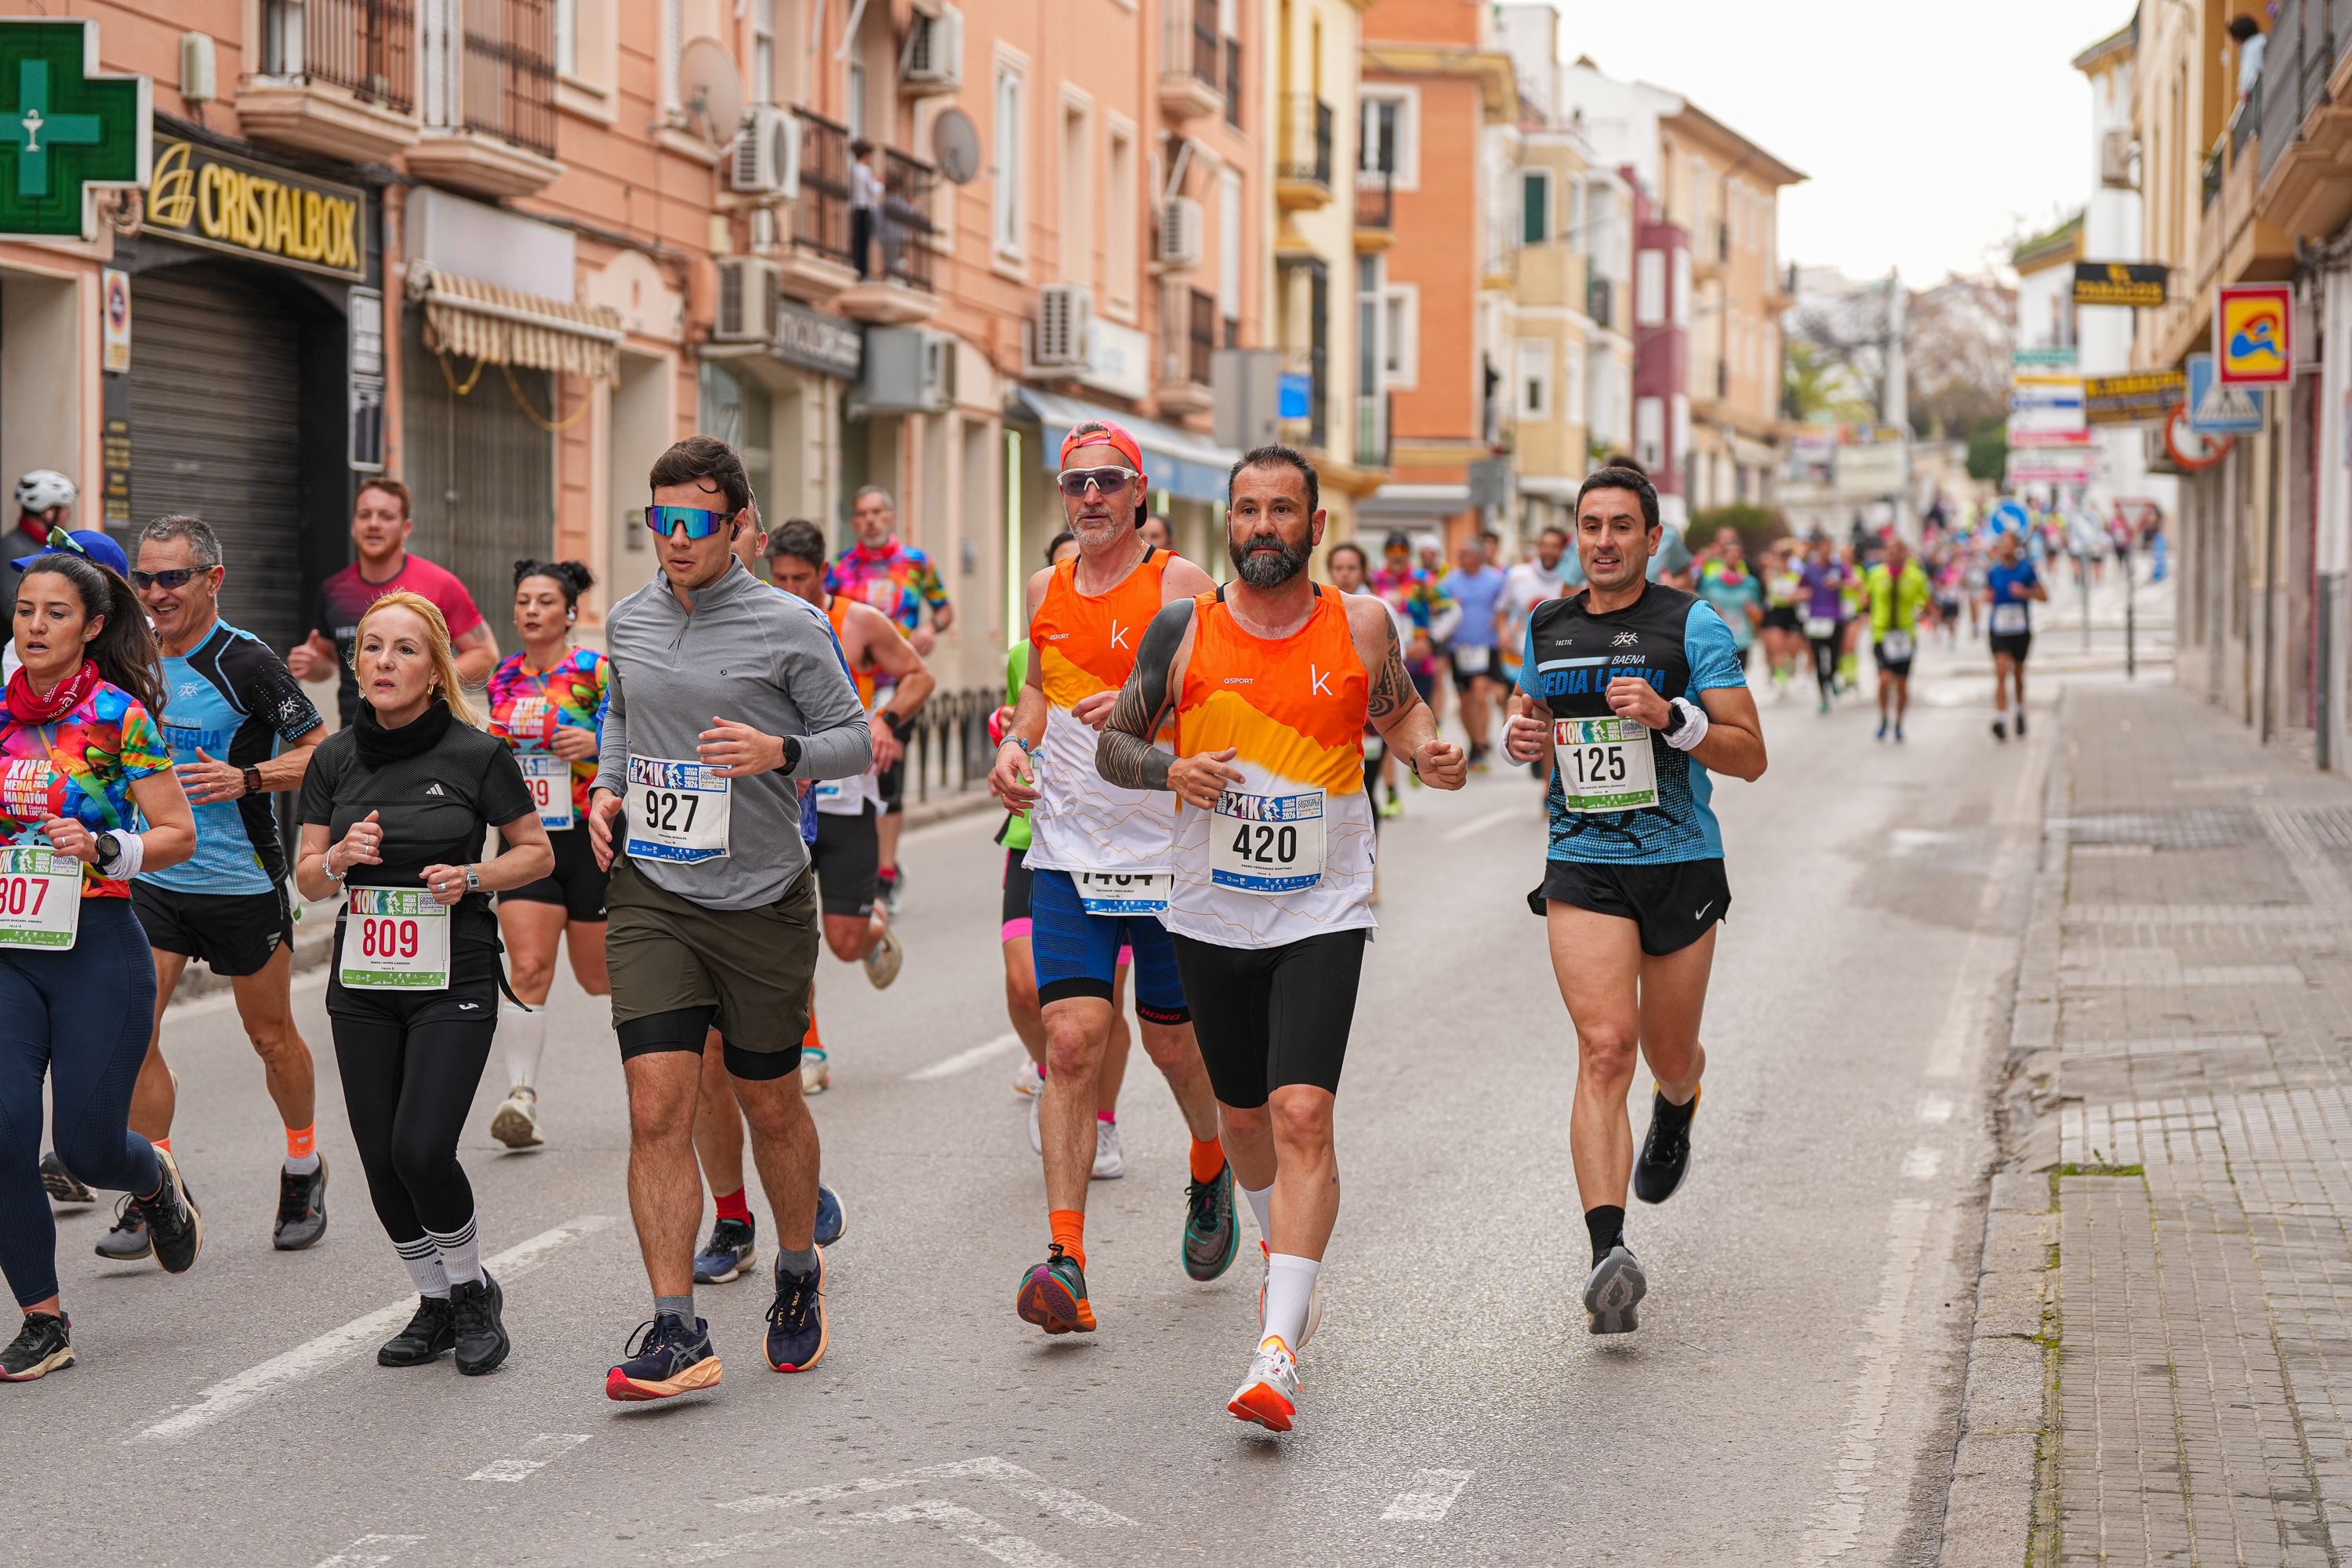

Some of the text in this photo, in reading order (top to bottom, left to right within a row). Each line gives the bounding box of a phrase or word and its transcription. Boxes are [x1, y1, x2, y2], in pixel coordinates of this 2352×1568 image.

[198, 162, 358, 268] CRISTALBOX
[1111, 619, 1130, 649] k
[1611, 655, 1646, 665] BAENA
[1311, 664, 1334, 696] k
[176, 717, 202, 728] BAENA
[1560, 722, 1586, 744] 10K
[5, 759, 53, 779] XII 08
[637, 760, 666, 787] 21K
[1573, 746, 1626, 782] 125
[3, 790, 48, 804] MARATÓN
[4, 779, 33, 792] MEDIA
[11, 804, 28, 815] 10K
[646, 789, 699, 833] 927
[1227, 793, 1261, 820] 21K
[1282, 811, 1296, 820] 2026
[1232, 824, 1297, 863] 420
[355, 890, 380, 914] 10K
[363, 919, 418, 958] 809
